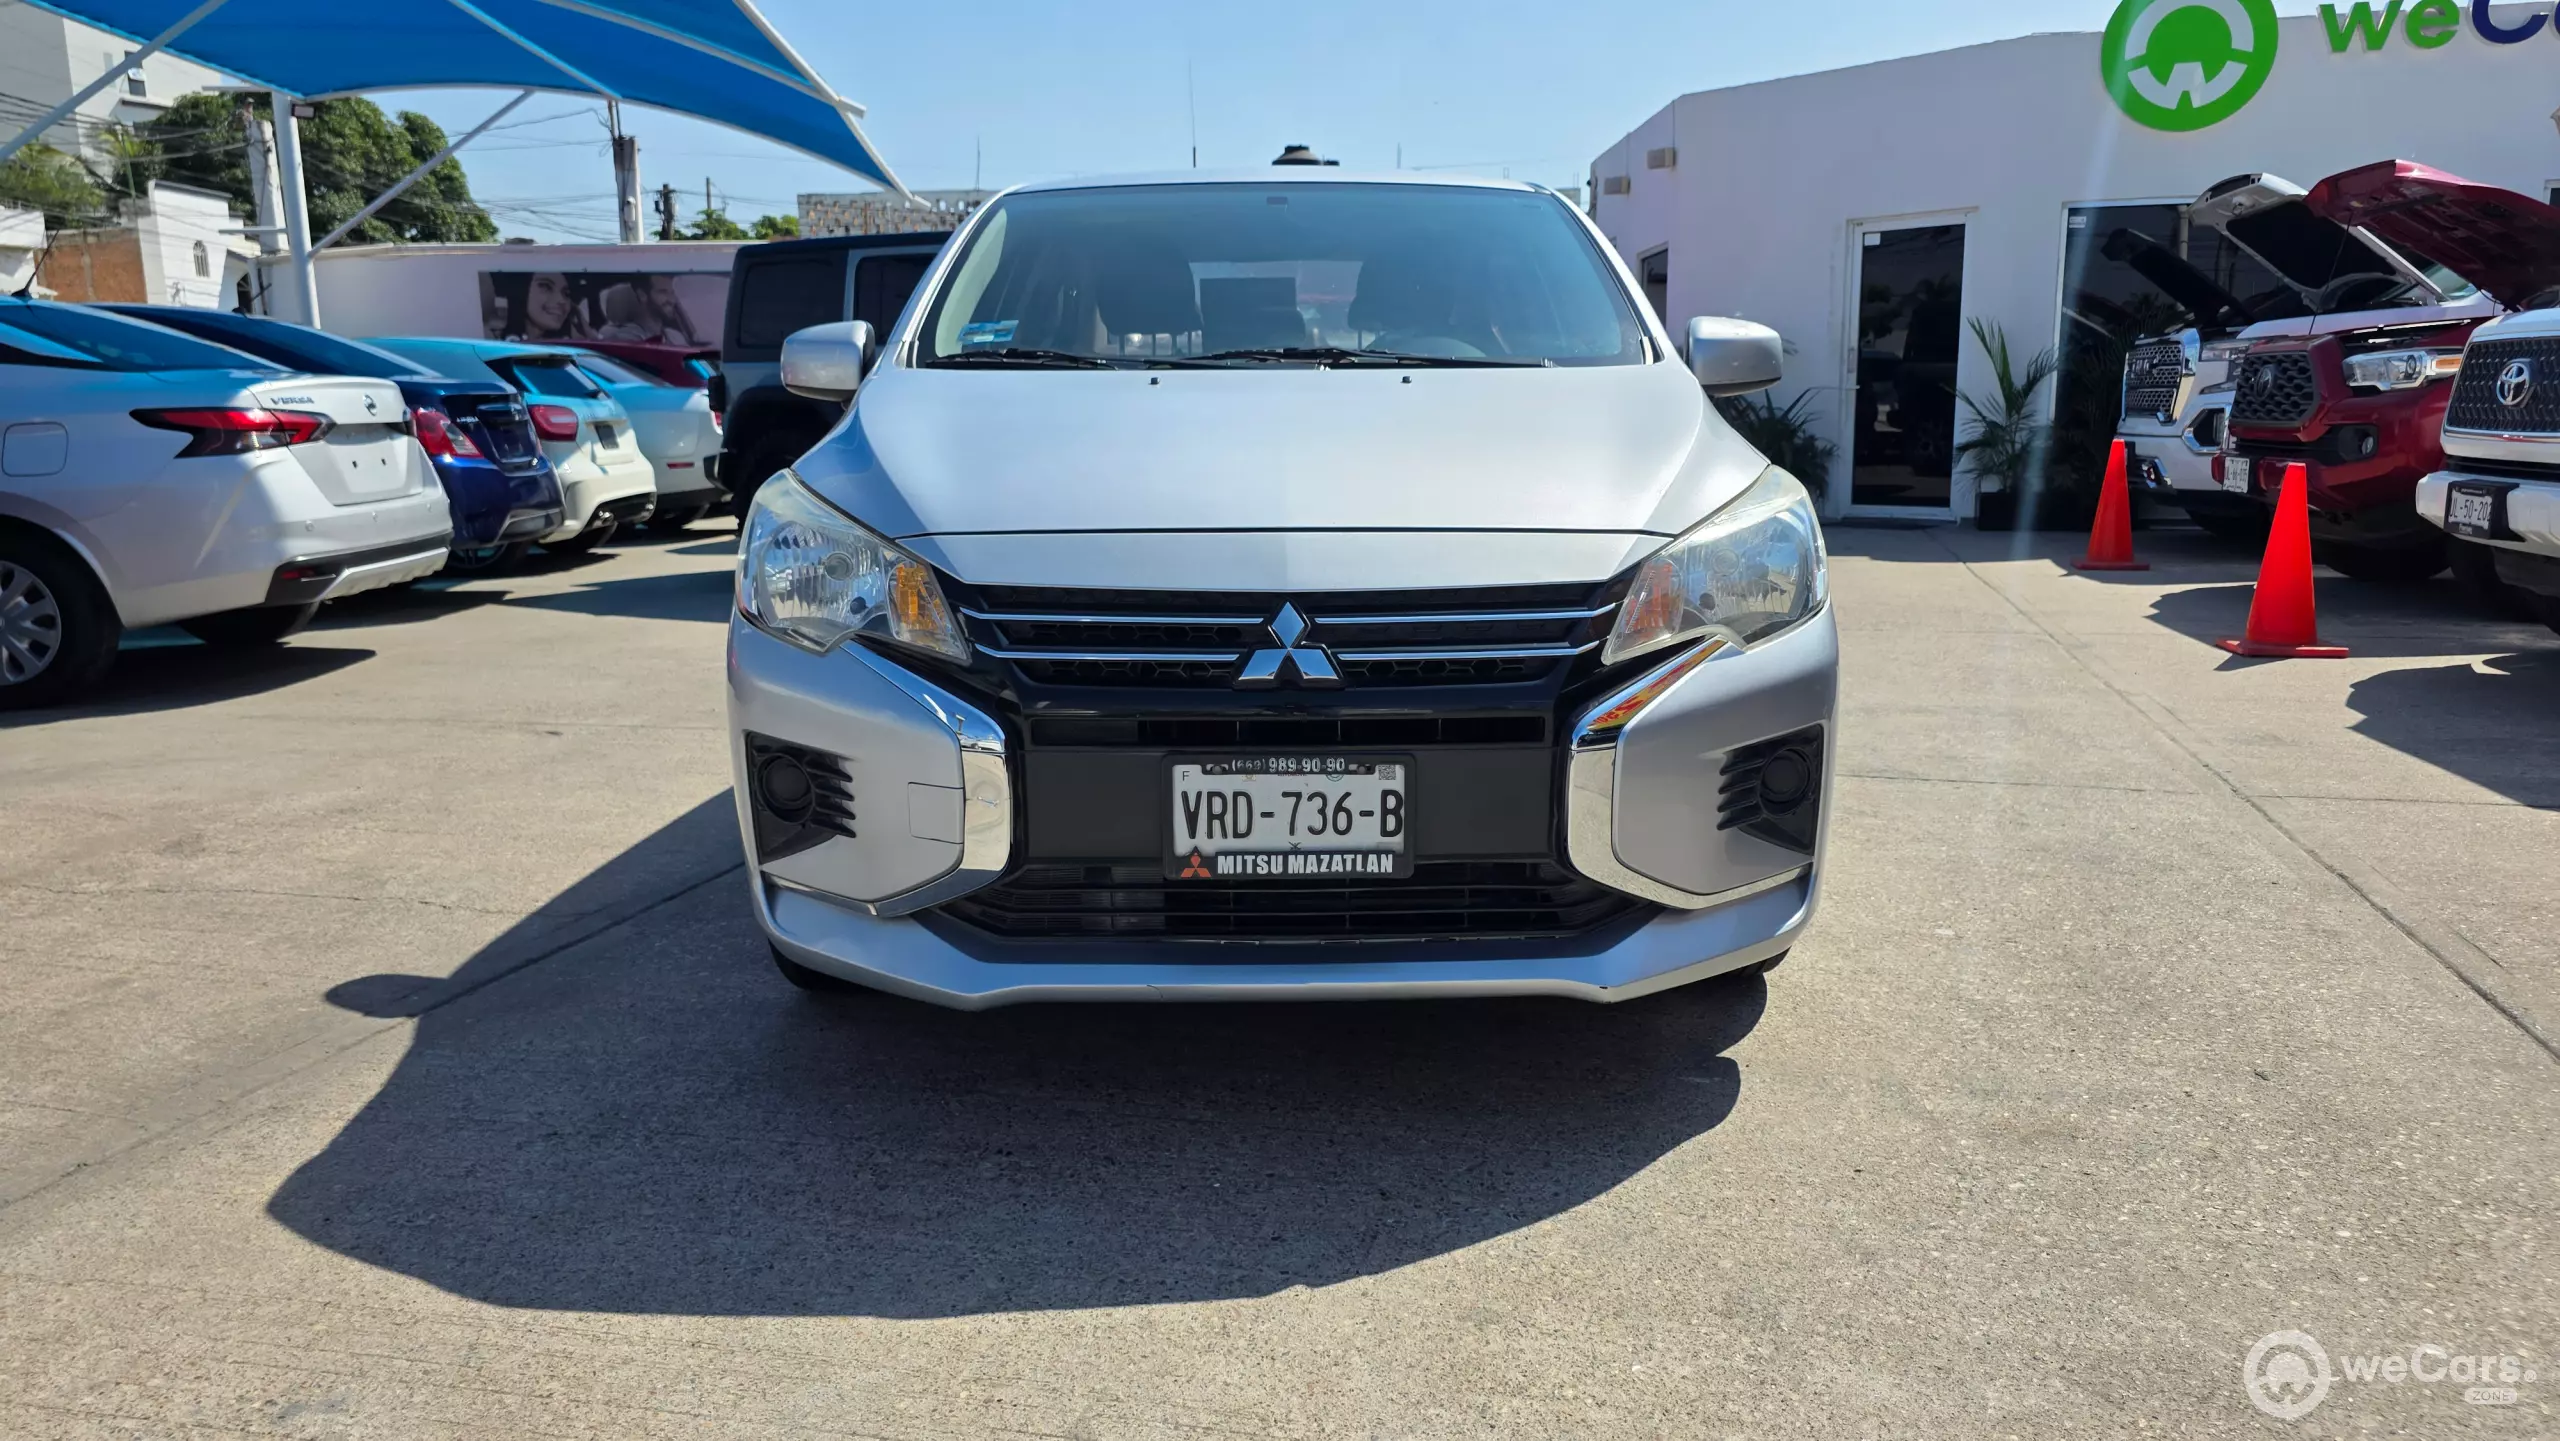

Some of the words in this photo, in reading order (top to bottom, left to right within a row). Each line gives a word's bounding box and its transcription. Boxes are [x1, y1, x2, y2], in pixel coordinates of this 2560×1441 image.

[1182, 771, 1190, 781] F
[1181, 790, 1403, 839] VRD-736-B
[1217, 854, 1283, 874] MITSU
[1288, 854, 1393, 874] MAZATLAN
